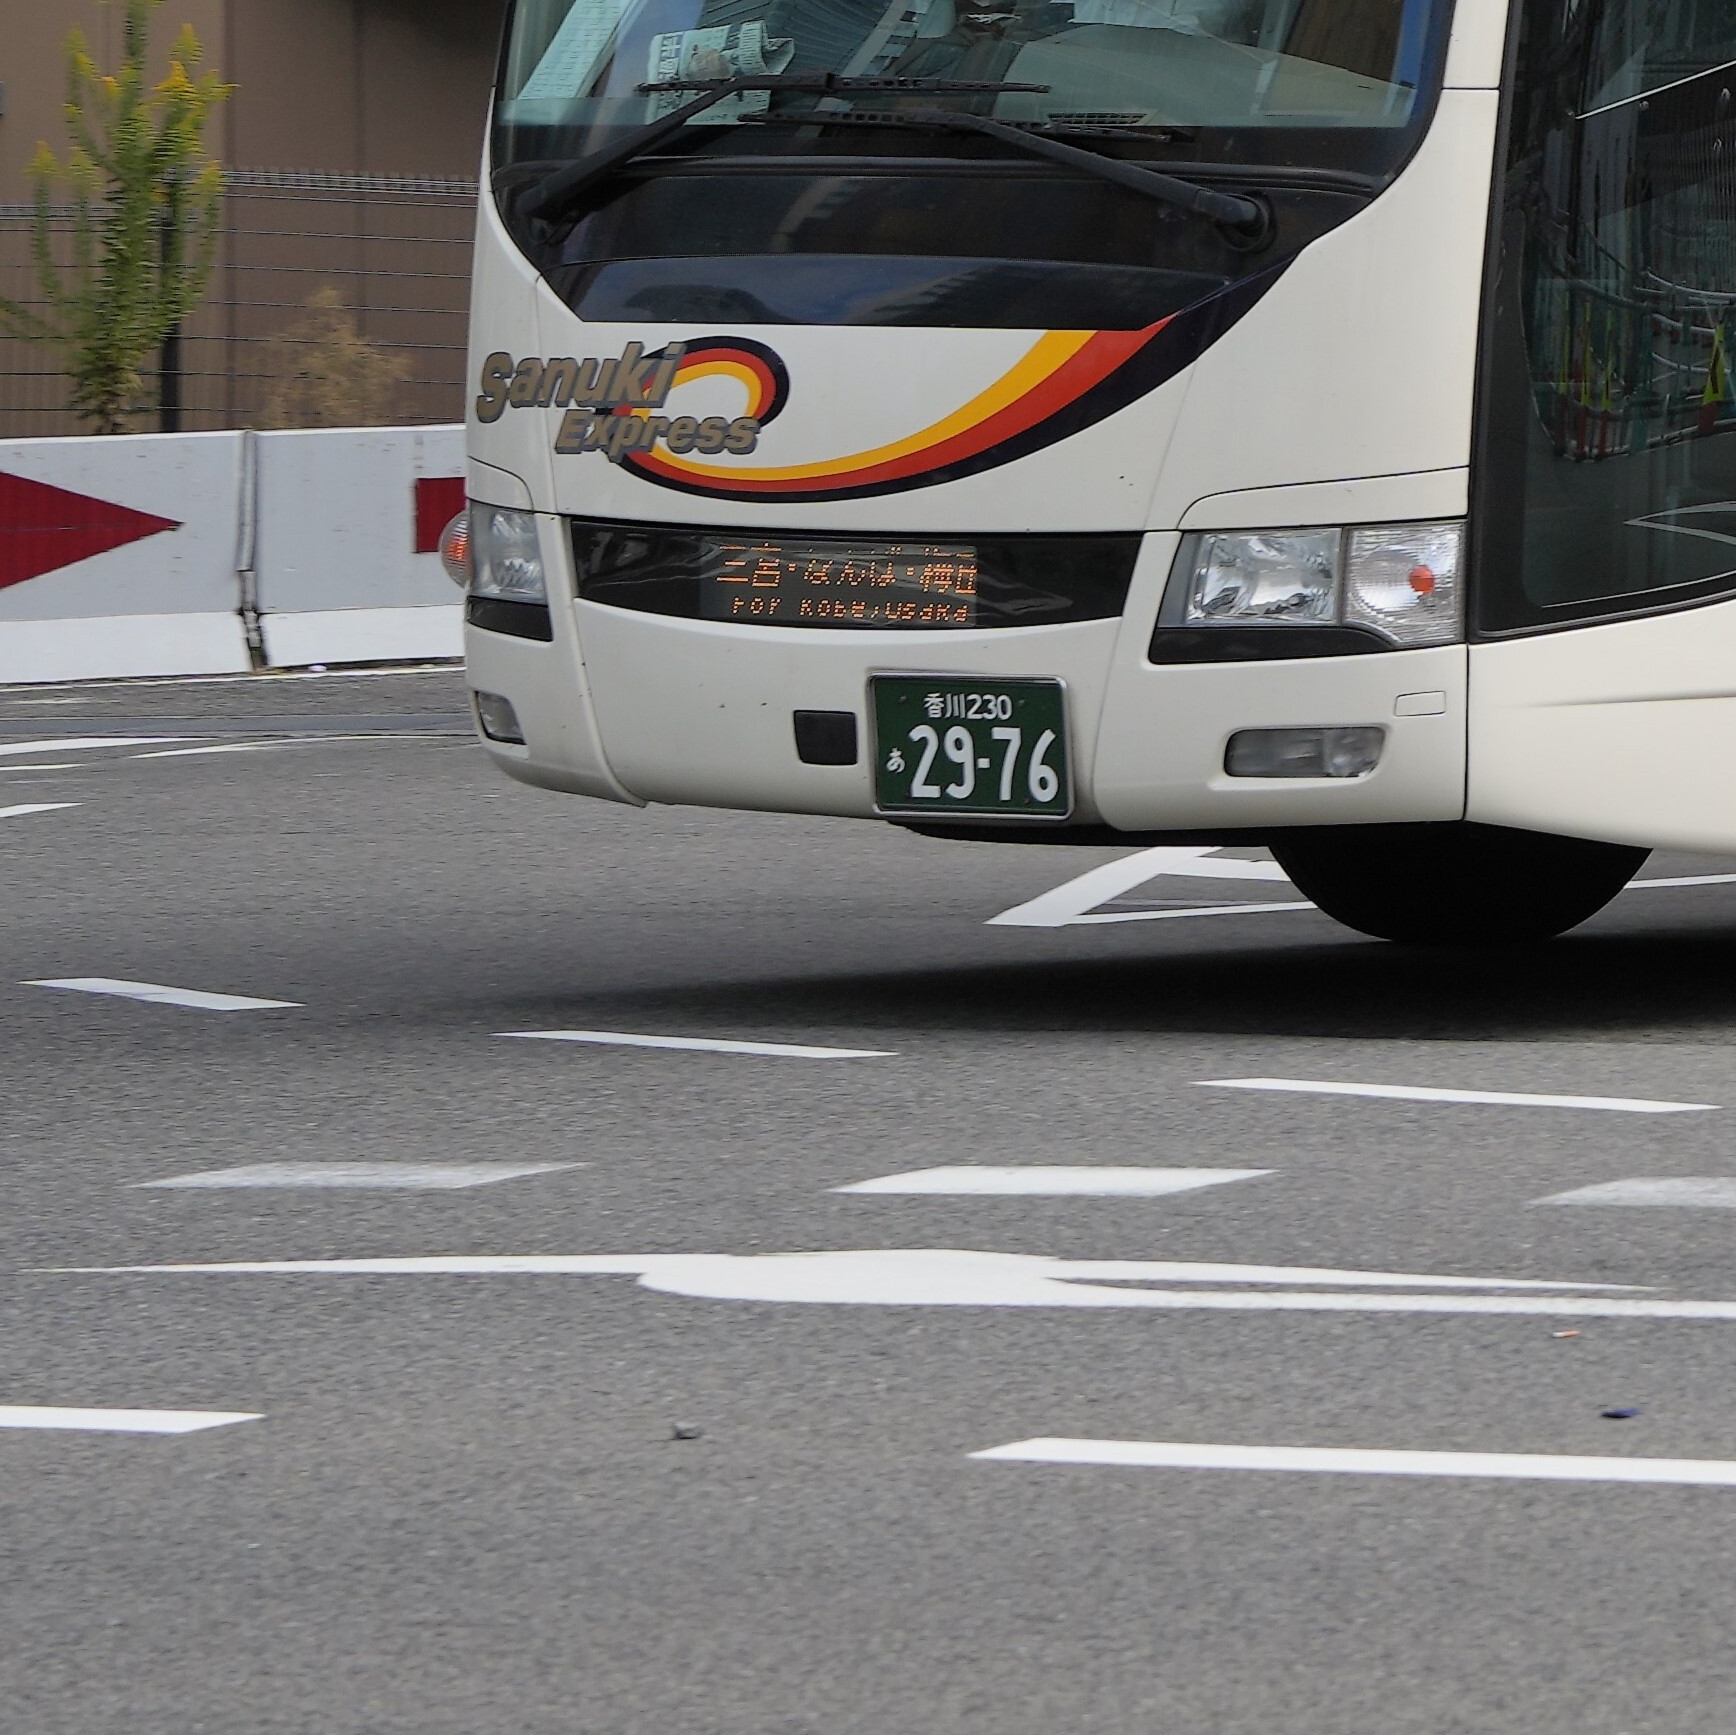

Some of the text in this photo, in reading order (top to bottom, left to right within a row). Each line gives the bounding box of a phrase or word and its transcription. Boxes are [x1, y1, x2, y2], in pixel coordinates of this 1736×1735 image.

[476, 340, 688, 424] Sanuki
[554, 408, 761, 464] Express
[885, 723, 1060, 804] あ 29-76
